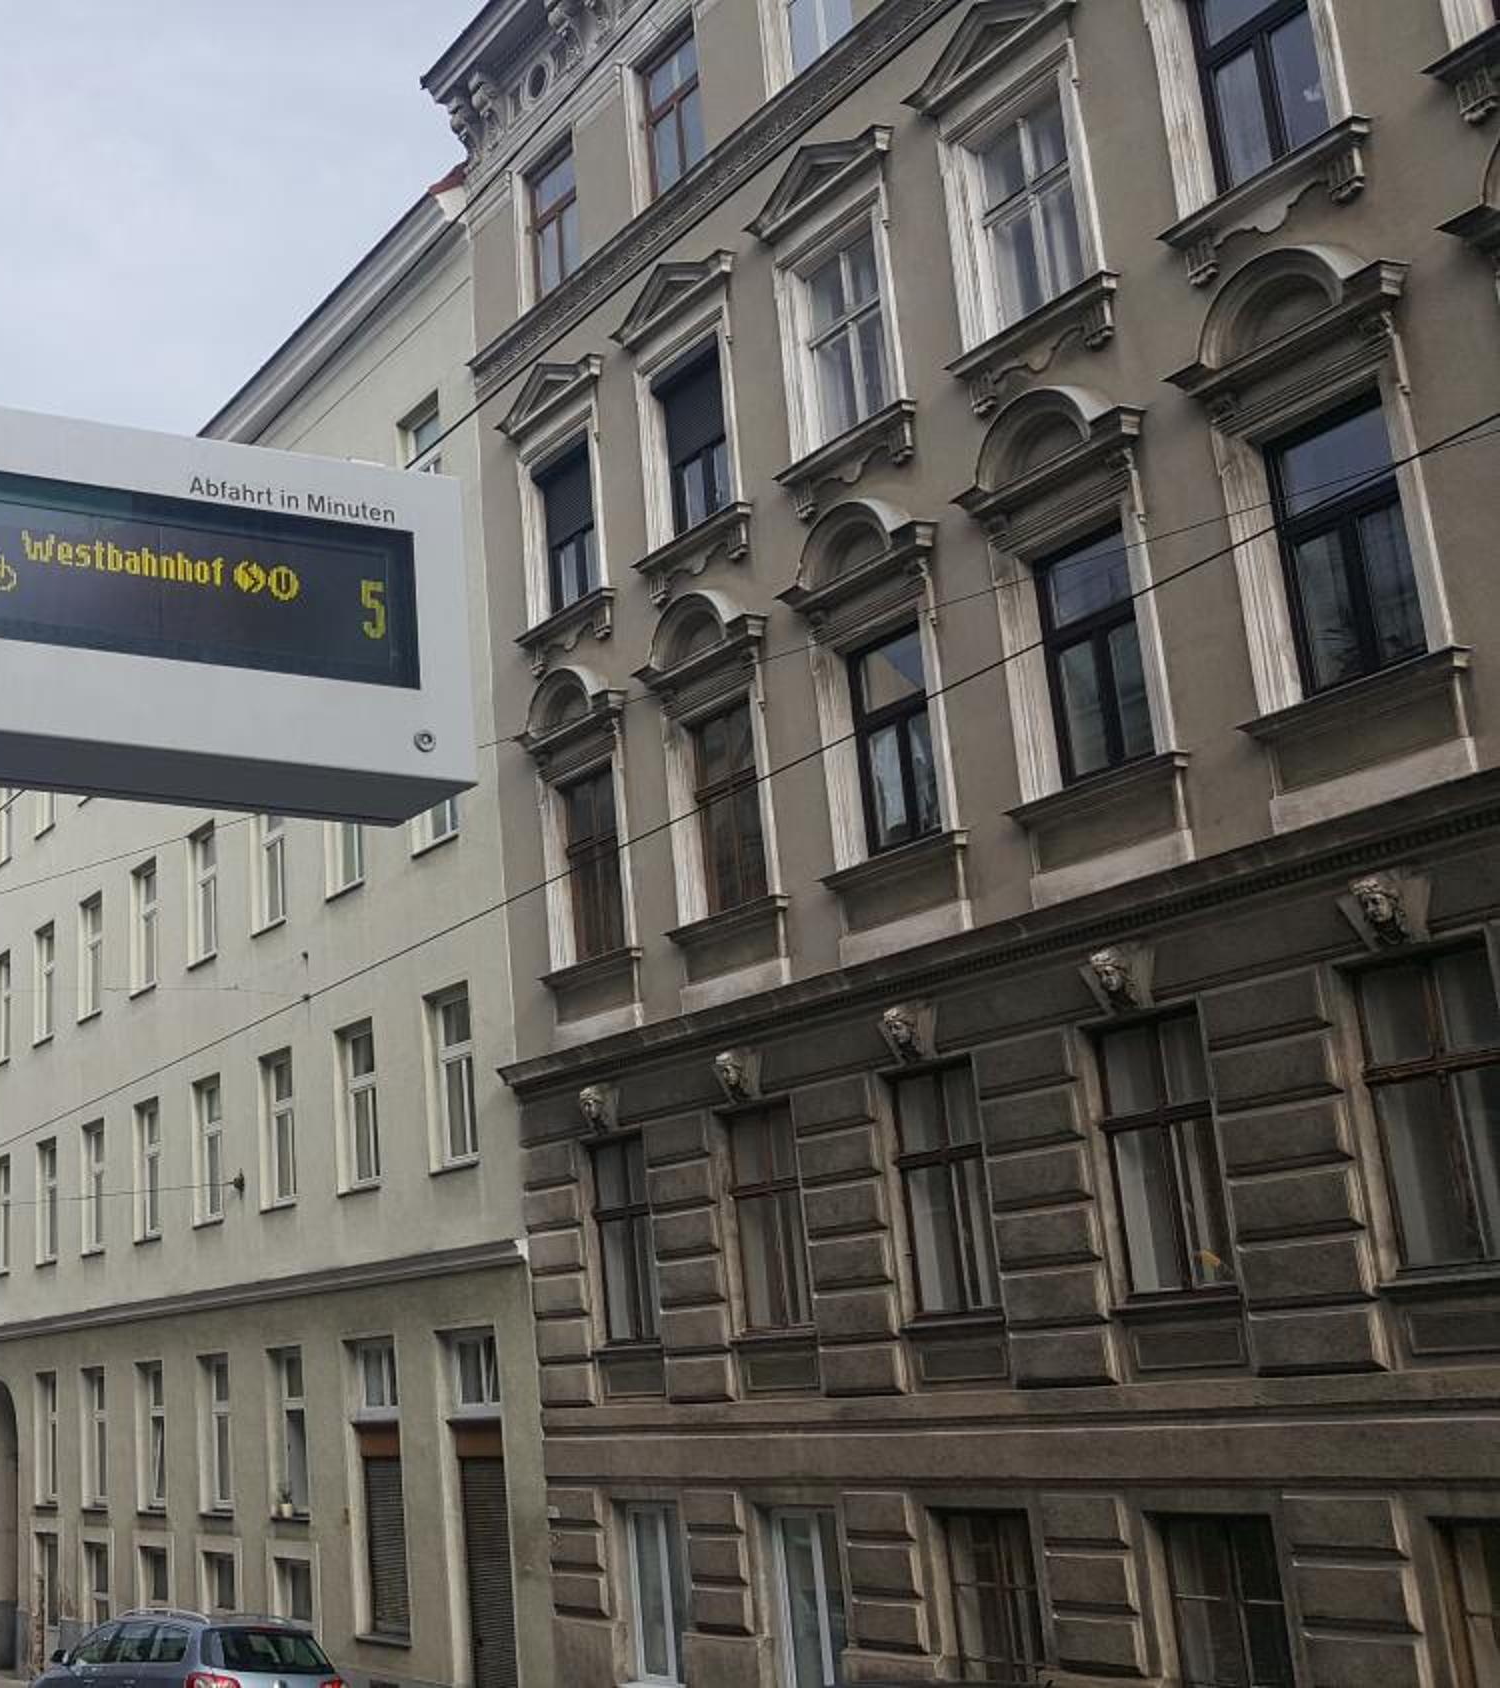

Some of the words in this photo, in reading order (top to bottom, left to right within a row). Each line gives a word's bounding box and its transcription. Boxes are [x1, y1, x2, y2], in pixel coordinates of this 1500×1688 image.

[189, 476, 274, 506] Abfahrt
[281, 489, 300, 510] in
[307, 493, 396, 524] Minuten
[21, 529, 224, 588] Westbahnhof
[361, 579, 386, 640] 5
